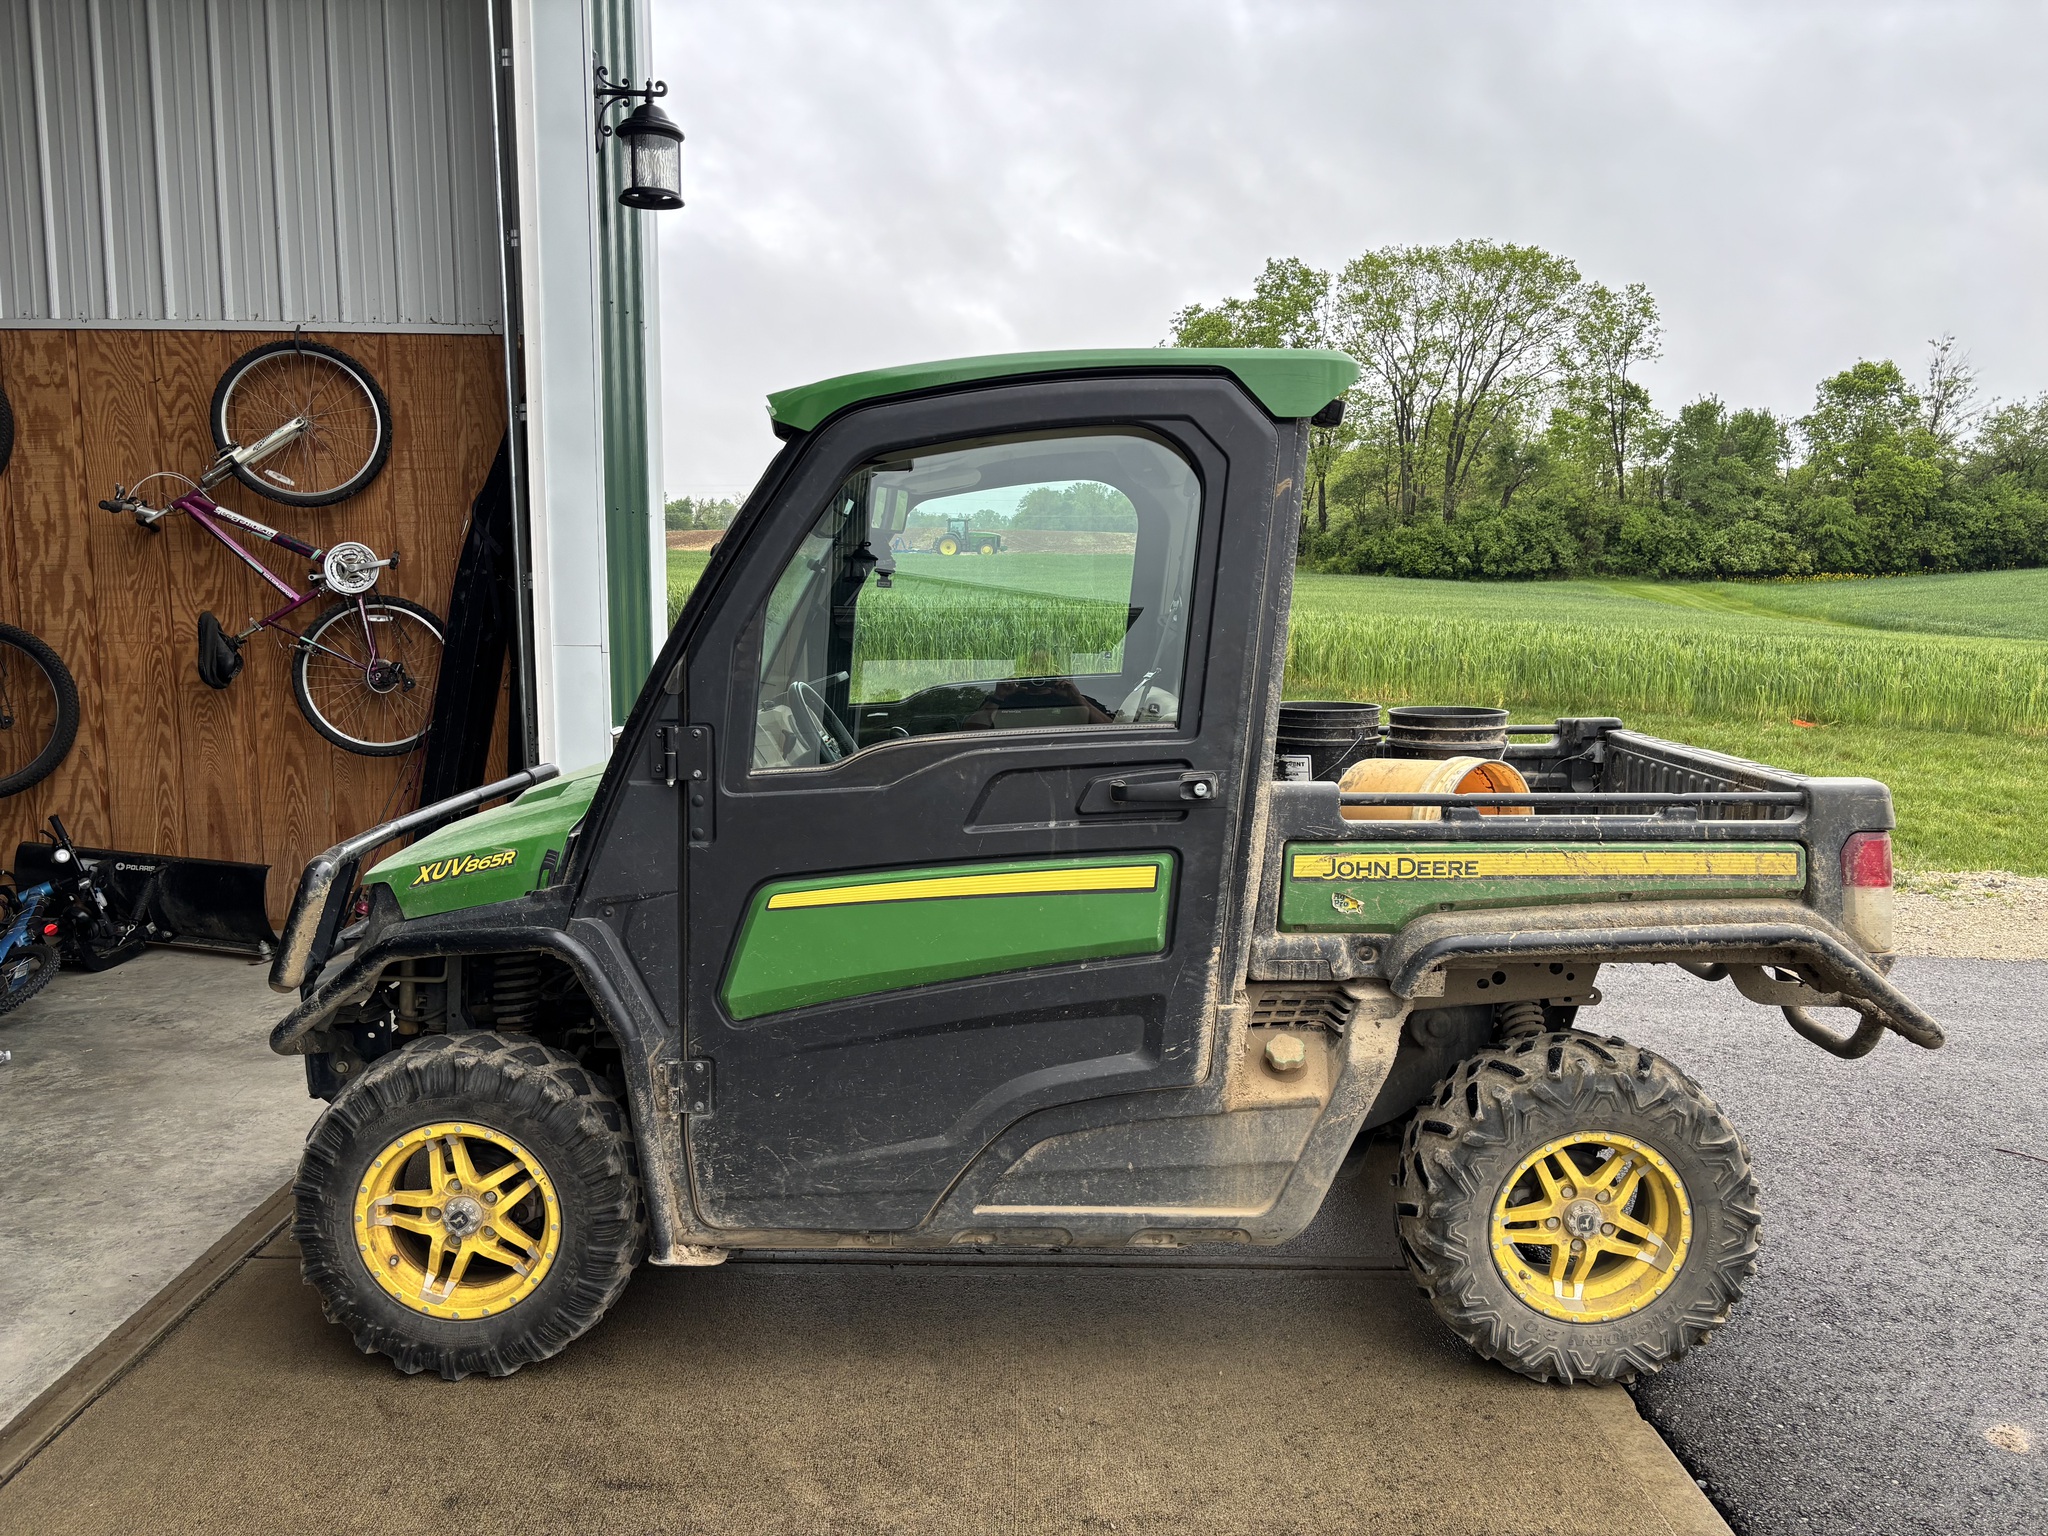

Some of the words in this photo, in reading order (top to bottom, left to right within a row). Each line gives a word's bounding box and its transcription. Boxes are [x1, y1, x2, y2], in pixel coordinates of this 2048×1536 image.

[125, 864, 156, 872] POLARIS
[413, 851, 516, 885] XUV865R
[1323, 858, 1390, 876] JOHN
[1397, 857, 1479, 876] DEERE
[1334, 899, 1349, 907] Pro
[1567, 1302, 1678, 1348] BIGHORN
